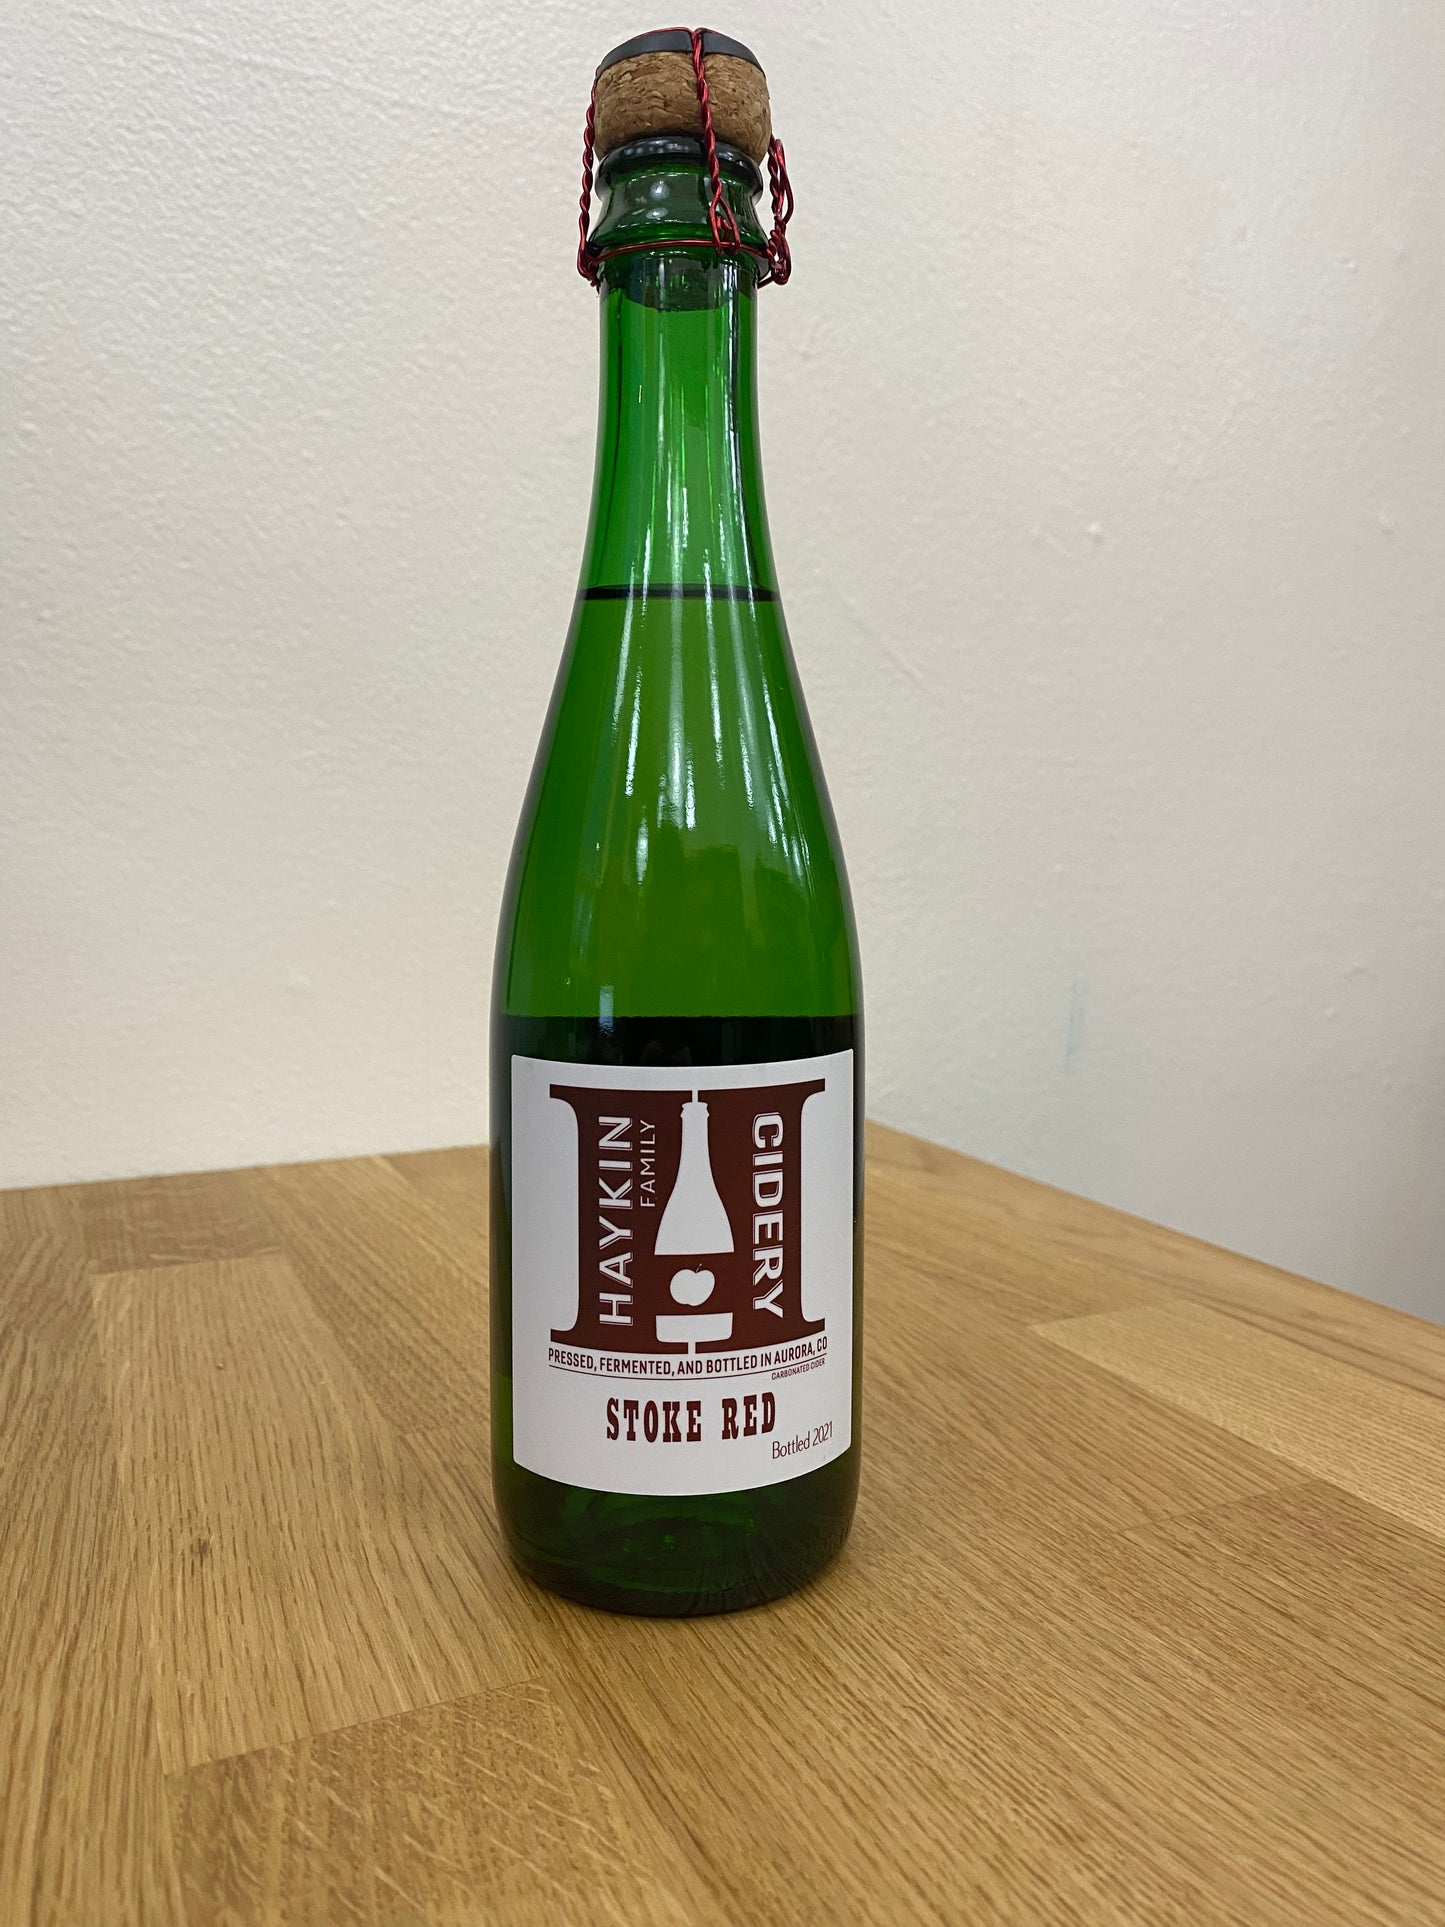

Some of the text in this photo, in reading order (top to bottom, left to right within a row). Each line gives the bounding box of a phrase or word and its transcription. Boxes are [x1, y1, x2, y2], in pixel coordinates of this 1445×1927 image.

[640, 1119, 656, 1208] FAMILY
[598, 1115, 633, 1326] HAYKIN
[752, 1111, 784, 1318] CIDERY
[549, 1336, 828, 1377] PRESSED, FERMENTED, AND BOTTLED IN AURORA, CO
[771, 1357, 826, 1380] CARBONATED CIDER
[606, 1391, 776, 1443] STOKE RED
[772, 1420, 833, 1459] Bottled 2021
